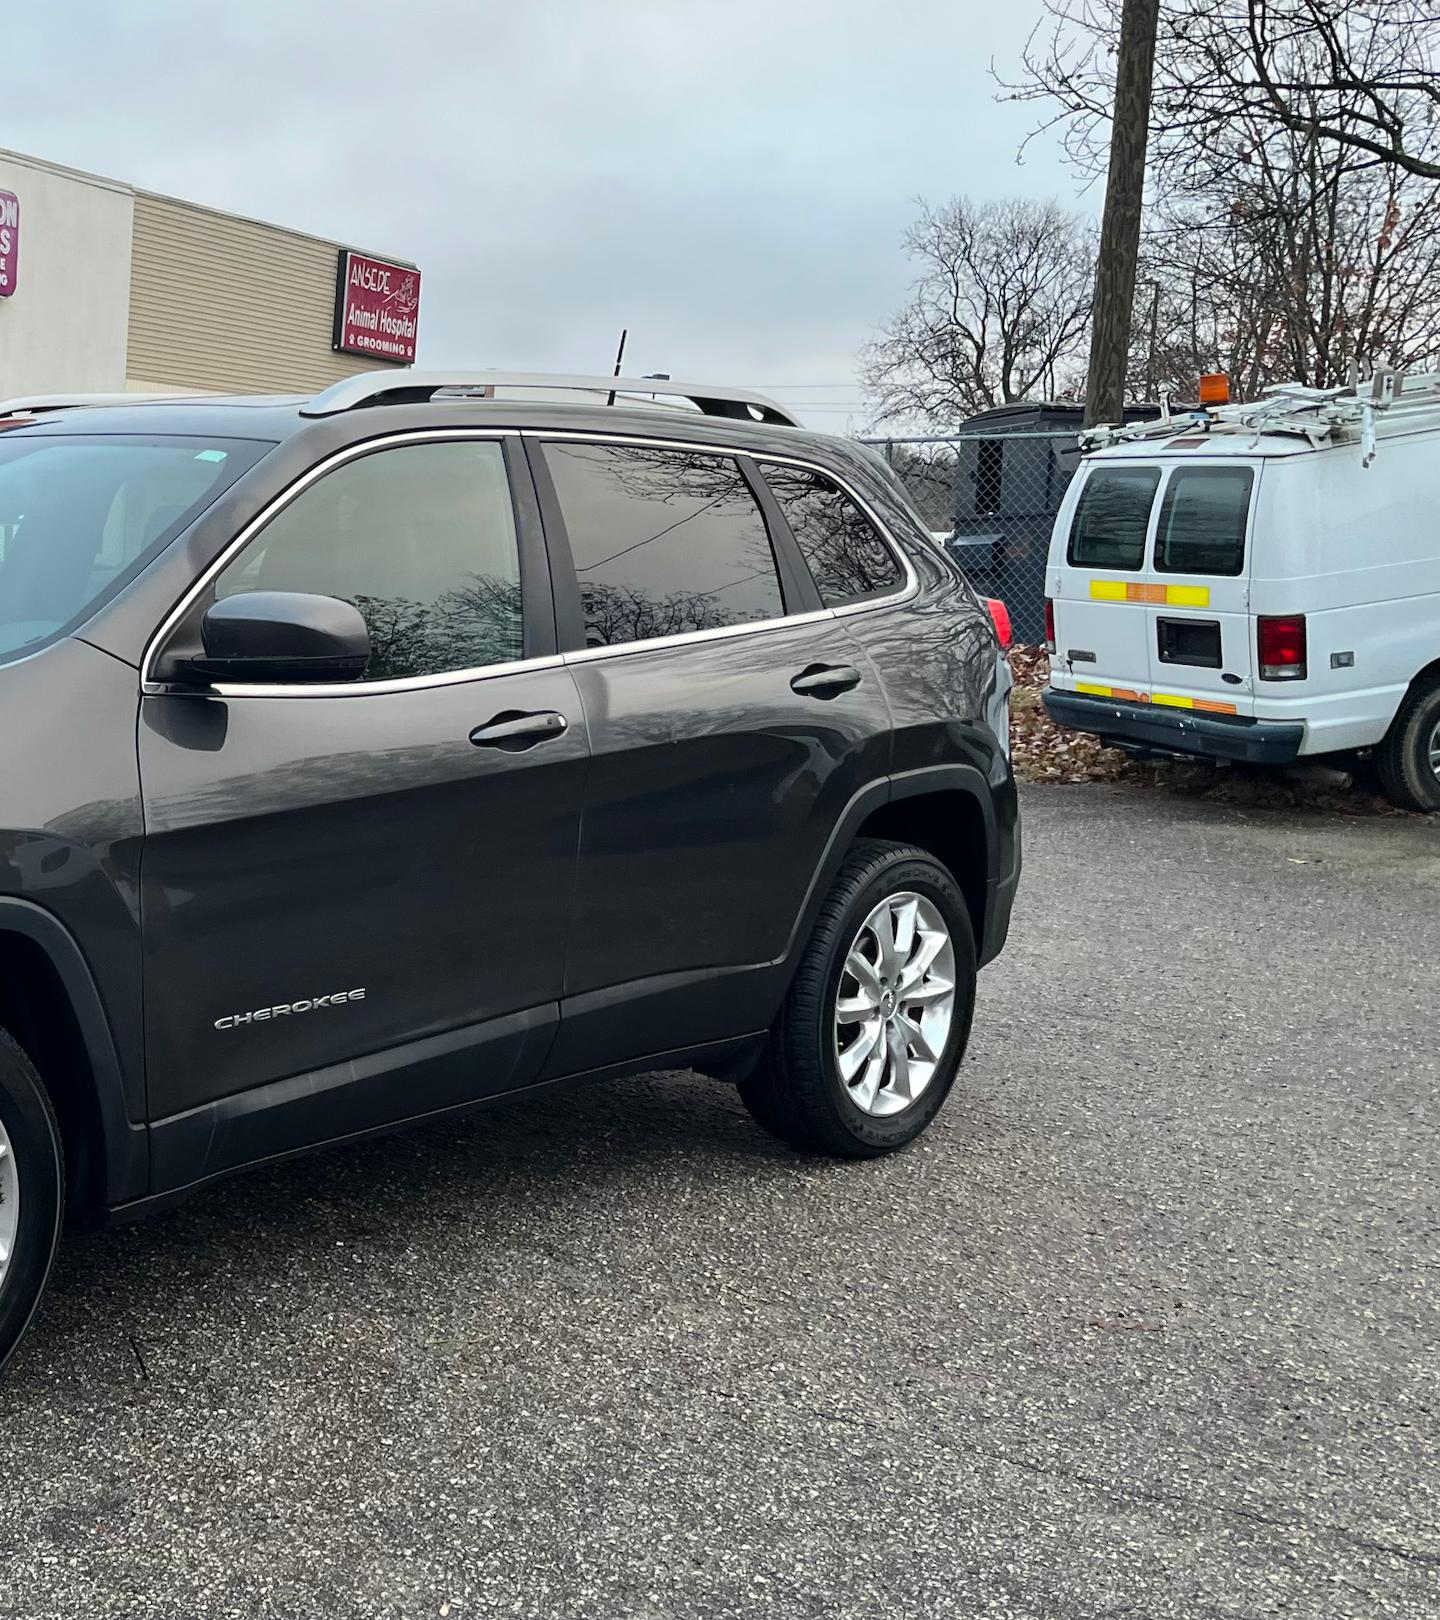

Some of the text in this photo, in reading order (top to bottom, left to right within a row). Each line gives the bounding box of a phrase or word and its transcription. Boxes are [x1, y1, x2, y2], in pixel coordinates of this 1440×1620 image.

[347, 303, 416, 340] Animal Hospital
[357, 335, 405, 355] GROOMING
[214, 987, 366, 1030] CHEROKEE
